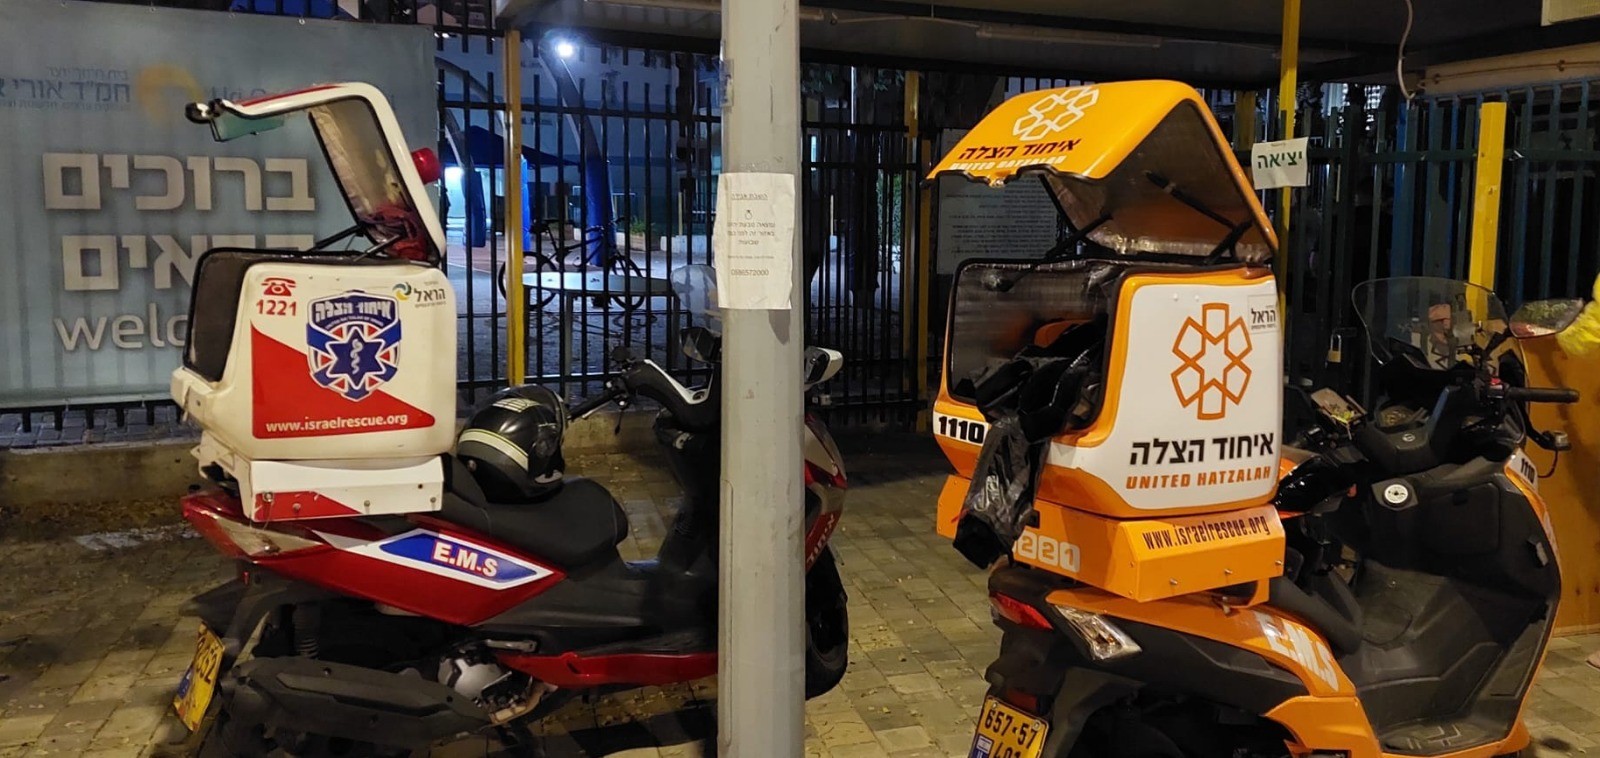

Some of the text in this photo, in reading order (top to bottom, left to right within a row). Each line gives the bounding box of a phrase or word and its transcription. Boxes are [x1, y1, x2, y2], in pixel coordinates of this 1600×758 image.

[11, 78, 63, 100] אורי
[958, 138, 1082, 160] איחוד הצלה
[1257, 151, 1303, 169] יציאה
[949, 161, 996, 171] UNITED
[43, 152, 315, 212] ברוכים
[62, 235, 314, 290] אים
[413, 287, 446, 302] הראל
[256, 299, 297, 316] 1221
[315, 300, 353, 323] הצלה
[355, 301, 392, 320] איחוד
[1251, 307, 1276, 324] הראל
[53, 302, 188, 352] welc
[265, 414, 408, 432] www.israelrescue.org
[939, 416, 985, 444] 1110
[1129, 432, 1274, 465] איחוד הצלה
[1126, 465, 1272, 490] UNITED HATZALAH
[1142, 515, 1271, 550] www.israelrescue.org
[433, 541, 498, 577] E.M.S
[1014, 532, 1077, 569] 221
[985, 709, 1038, 749] 657-57
